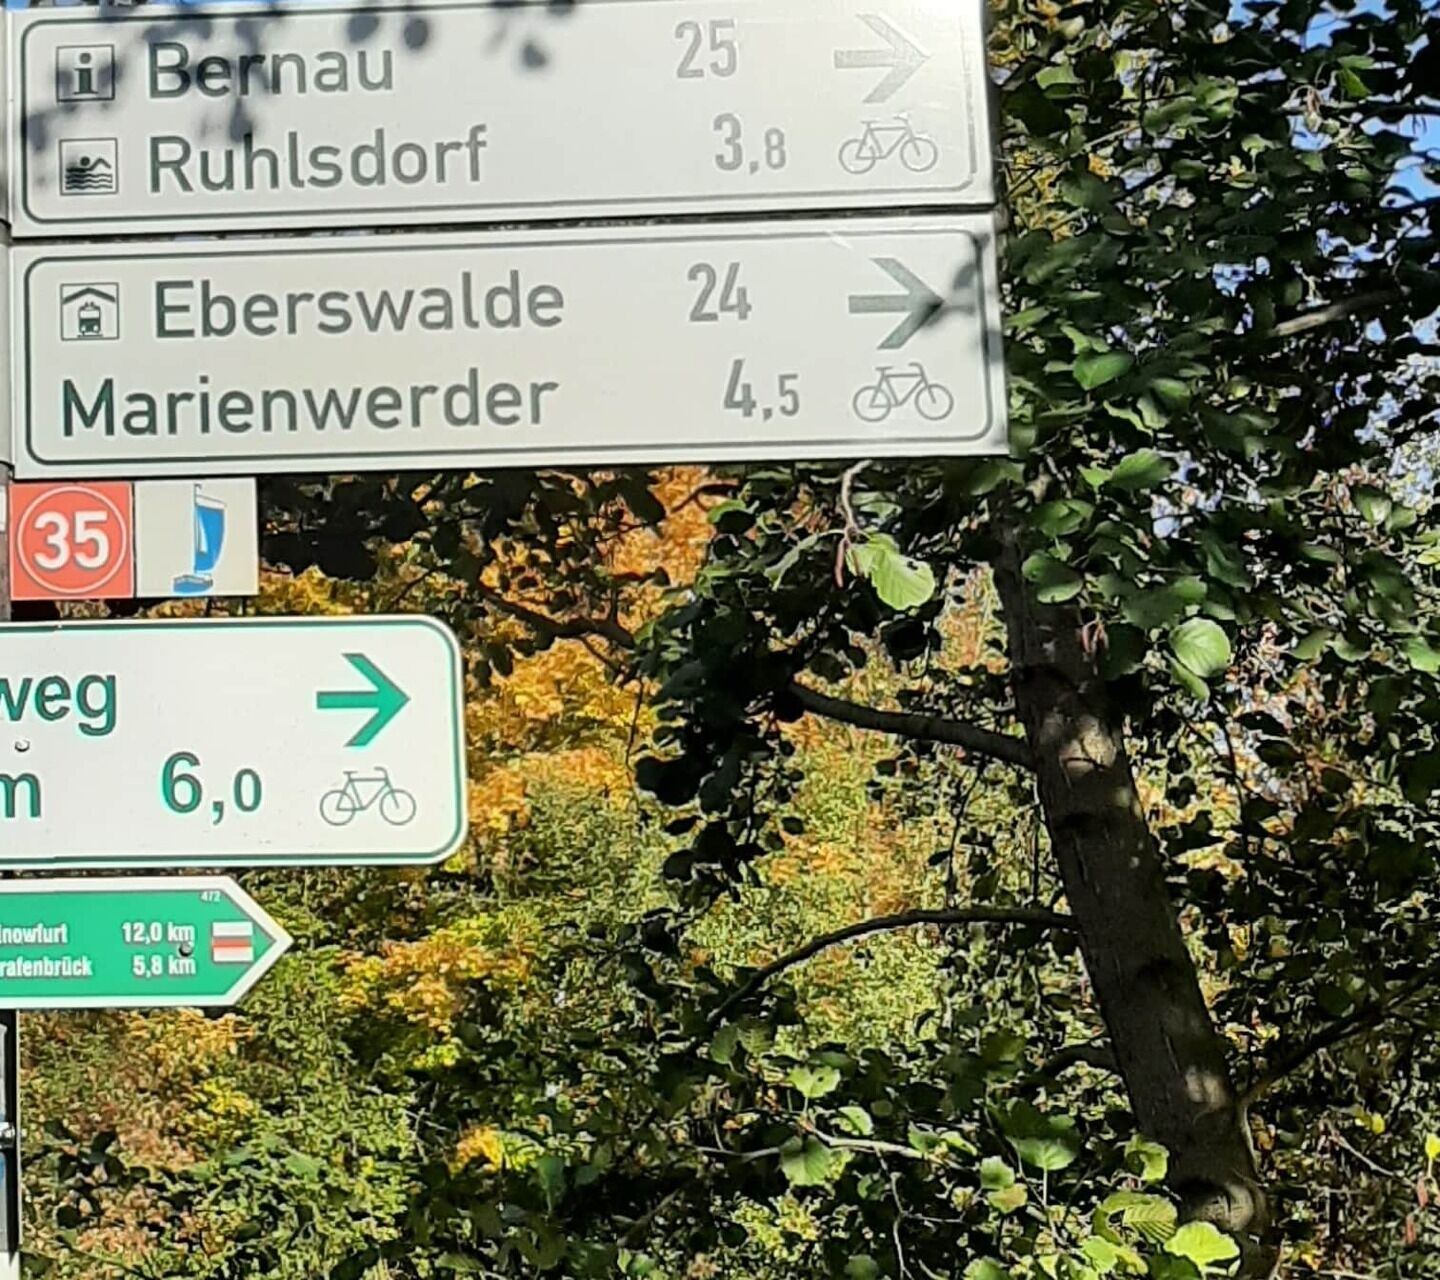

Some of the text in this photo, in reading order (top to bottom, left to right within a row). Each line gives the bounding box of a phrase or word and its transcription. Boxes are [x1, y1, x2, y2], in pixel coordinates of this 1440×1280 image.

[148, 19, 737, 101] Bernau 25
[148, 113, 786, 194] Ruhlsdorf 3,8
[155, 262, 752, 339] Eberswalde 24
[62, 360, 799, 437] Marienwerder 4,5
[33, 509, 111, 572] 35
[160, 750, 262, 825] 6,0
[122, 921, 161, 944] 12,0
[167, 922, 195, 942] km
[133, 955, 162, 978] 5,8
[168, 955, 197, 975] km
